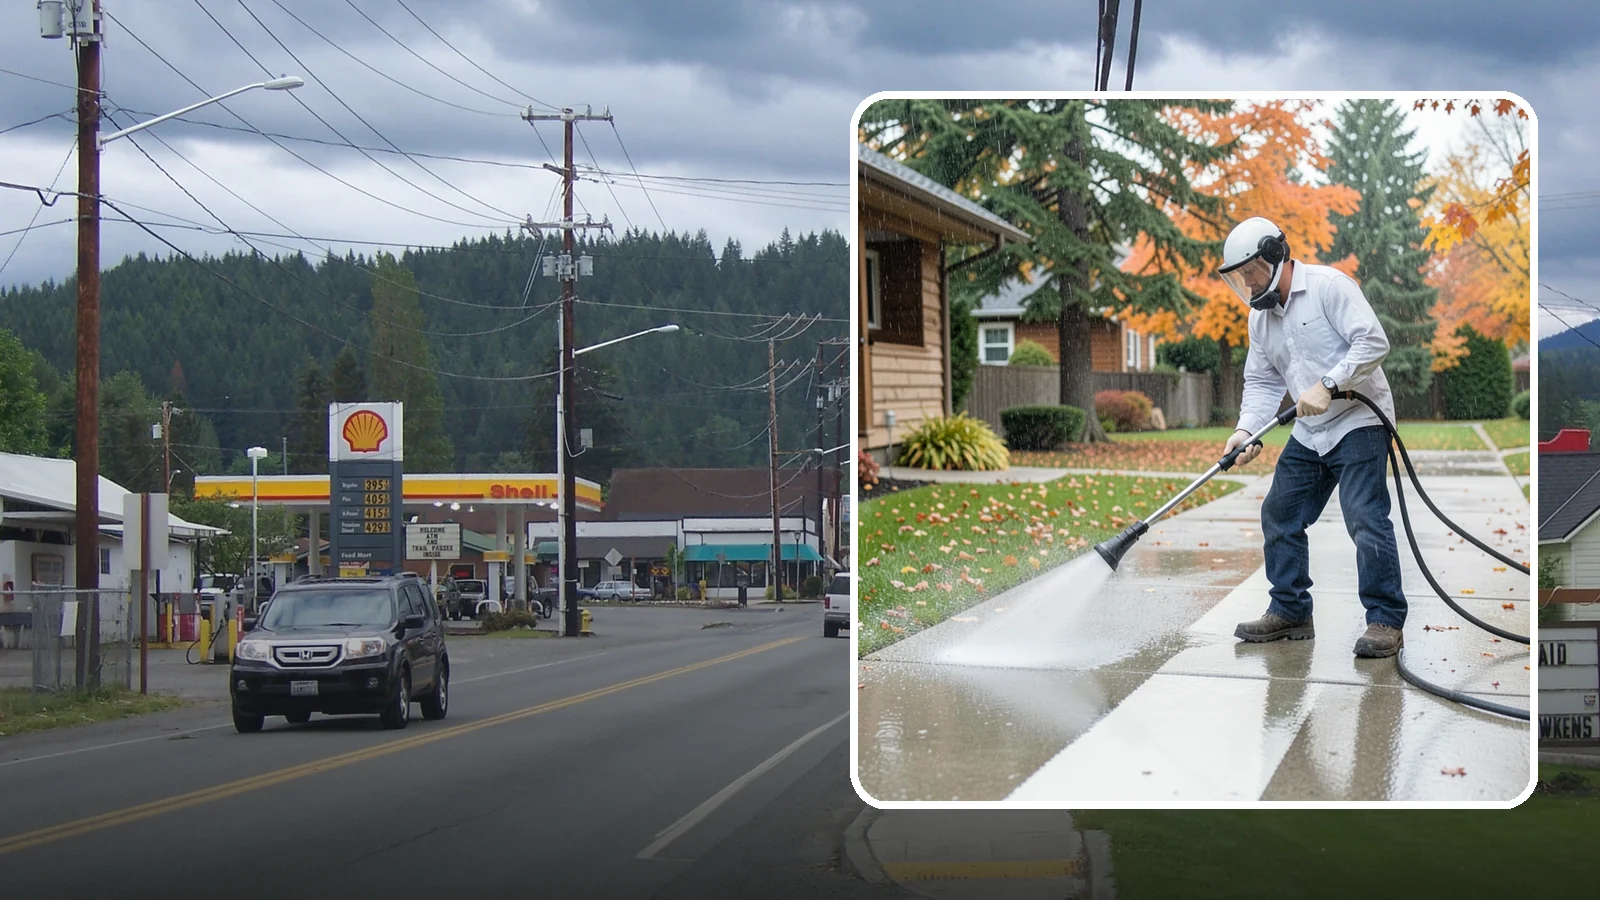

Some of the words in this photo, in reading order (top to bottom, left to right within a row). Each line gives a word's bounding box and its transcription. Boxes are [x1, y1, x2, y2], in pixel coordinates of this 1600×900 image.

[366, 480, 383, 490] 395
[490, 484, 547, 498] Shell
[366, 494, 383, 504] 405
[366, 508, 383, 518] 415
[366, 522, 383, 532] 429
